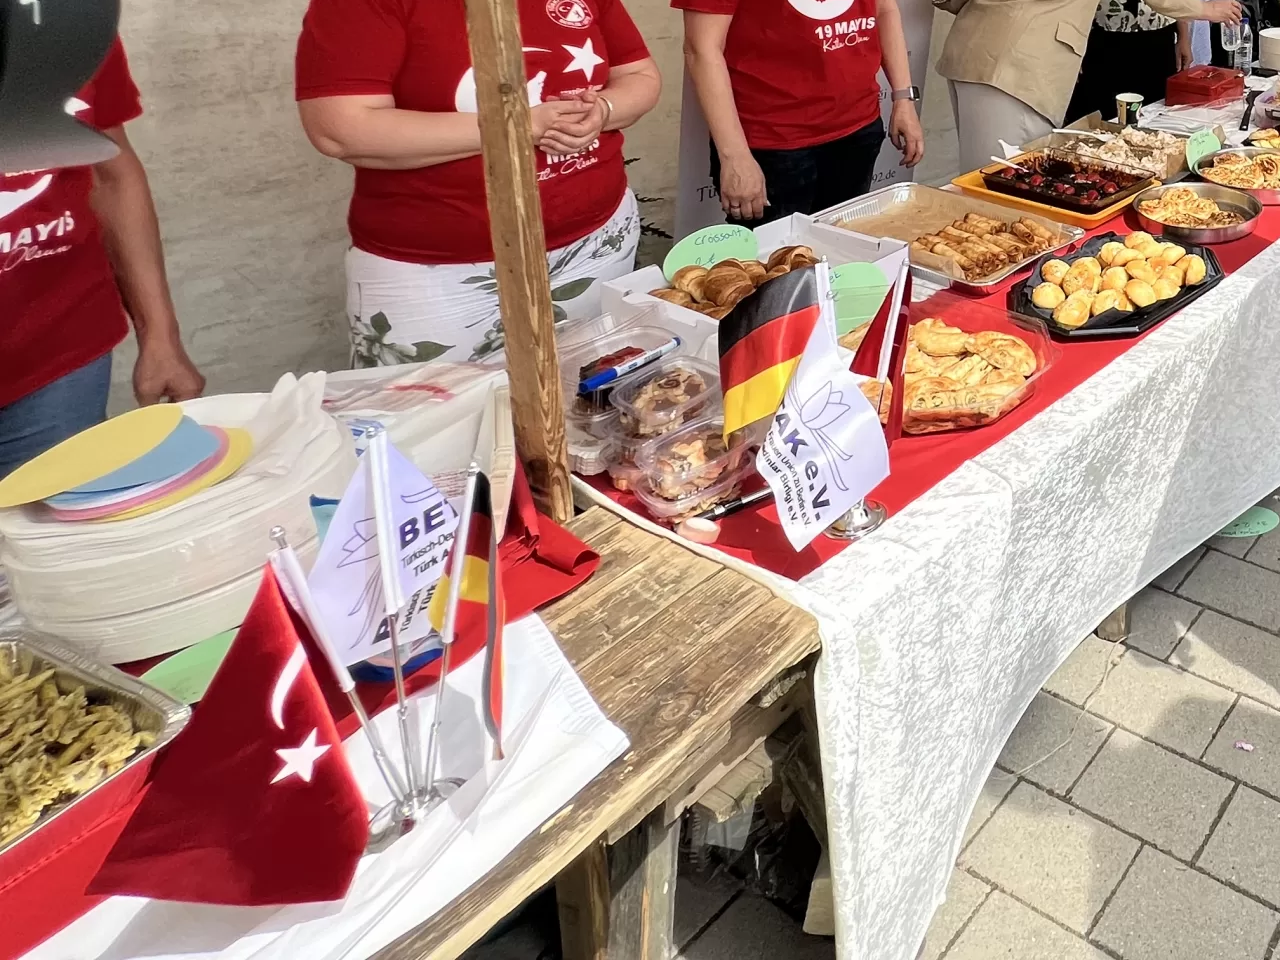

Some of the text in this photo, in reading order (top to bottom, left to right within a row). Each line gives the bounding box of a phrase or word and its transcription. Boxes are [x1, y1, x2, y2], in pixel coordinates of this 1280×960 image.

[815, 17, 876, 39] 19 MAYIS
[781, 455, 798, 478] Union
